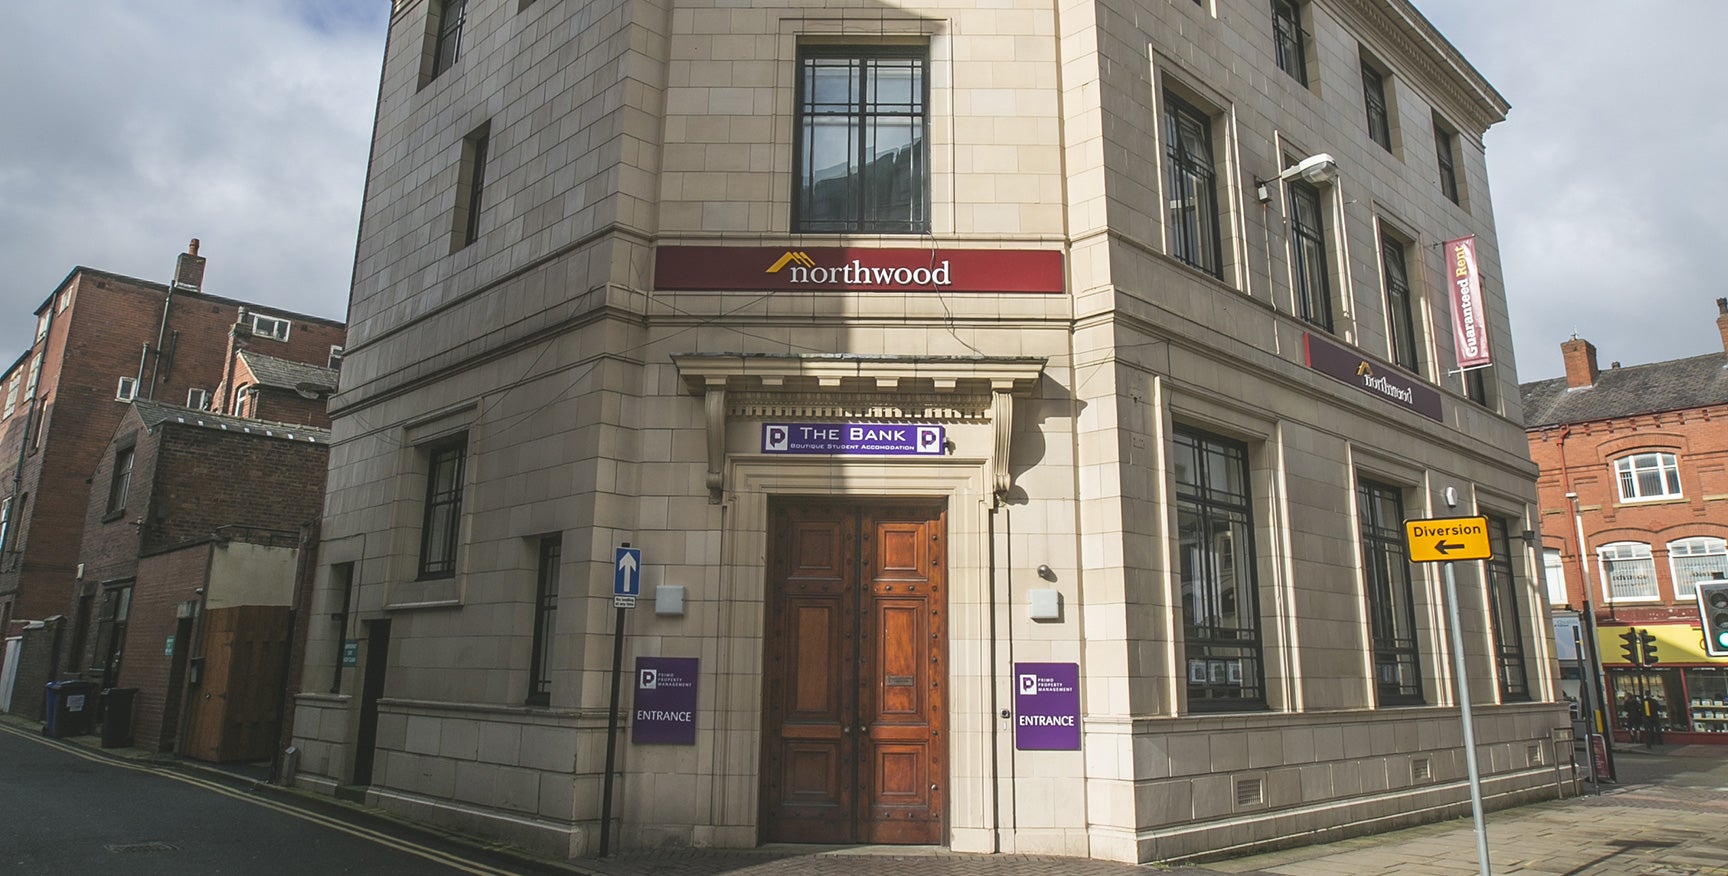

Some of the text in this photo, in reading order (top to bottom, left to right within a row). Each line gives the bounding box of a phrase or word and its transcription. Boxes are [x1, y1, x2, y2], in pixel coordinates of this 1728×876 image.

[790, 259, 952, 286] northwood
[1454, 245, 1479, 358] Guaranteed Rent
[1413, 524, 1481, 537] Diversion
[637, 710, 692, 722] ENTRANCE
[1019, 715, 1075, 726] ENTRANCE
